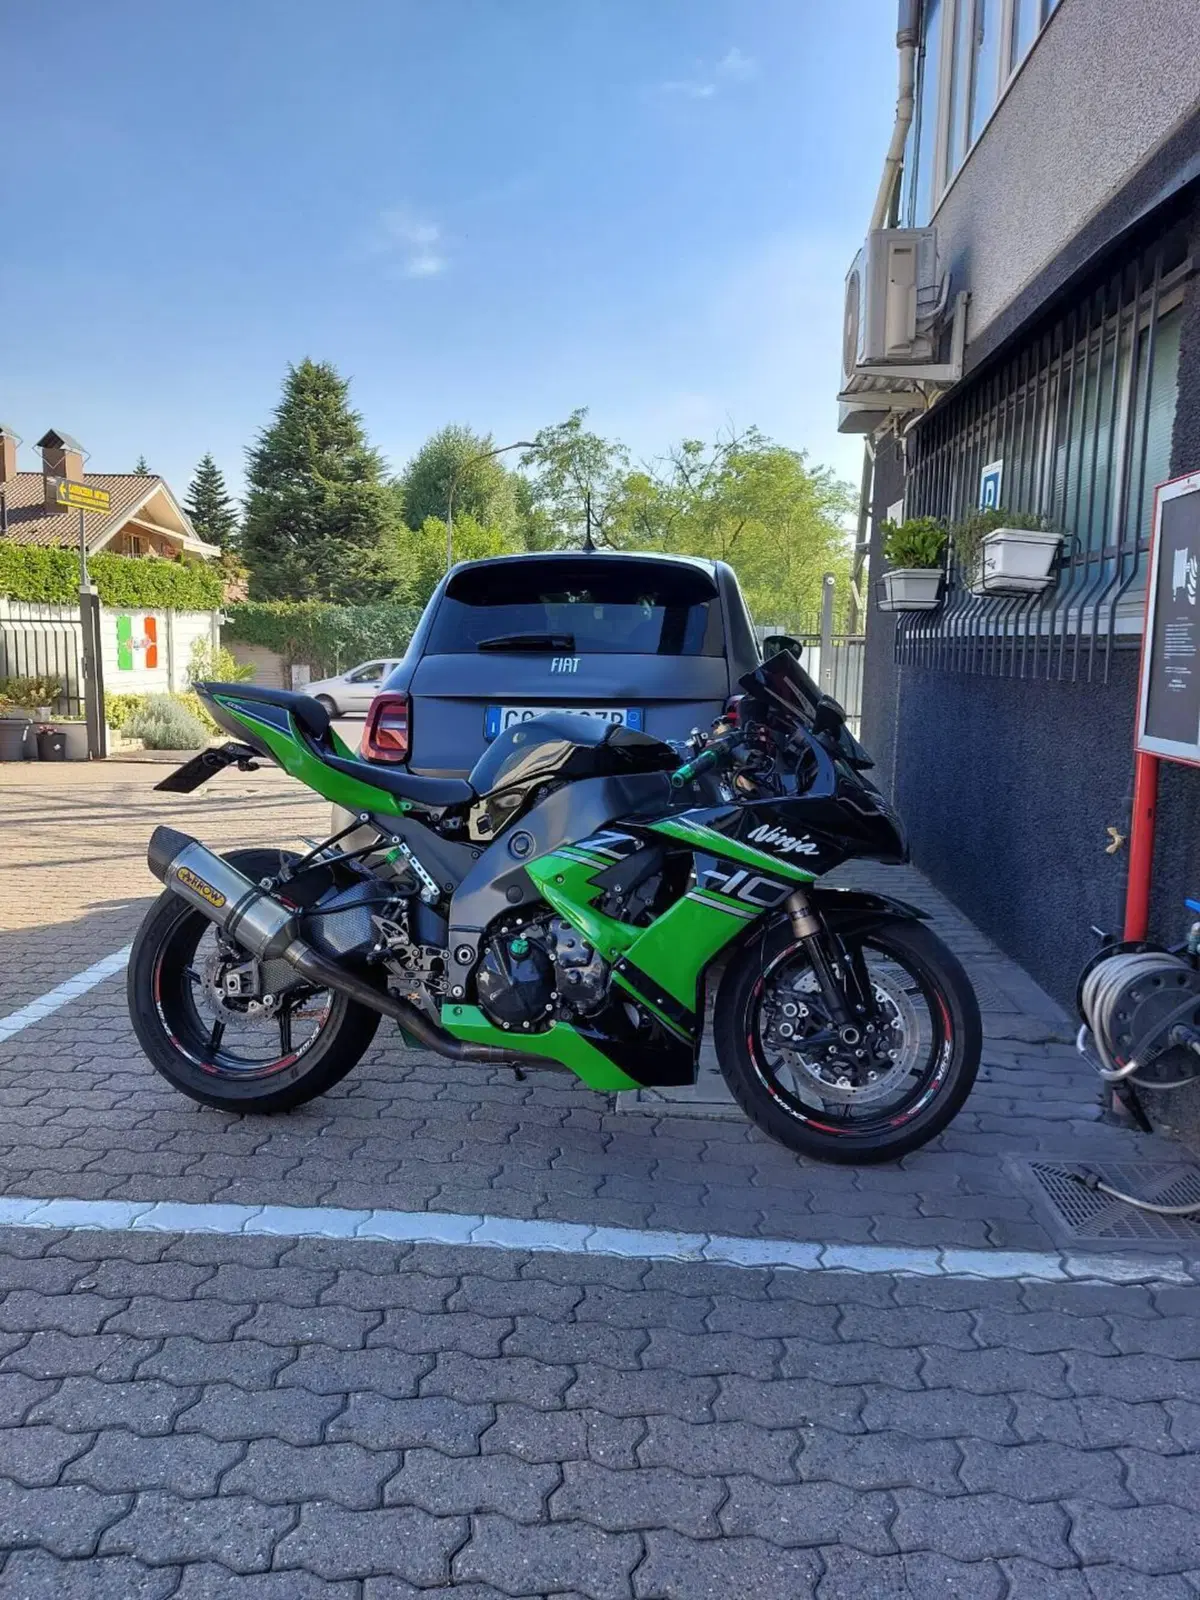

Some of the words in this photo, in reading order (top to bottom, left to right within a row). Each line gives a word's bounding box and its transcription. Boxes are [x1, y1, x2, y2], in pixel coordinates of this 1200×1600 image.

[550, 657, 582, 673] FIAT
[747, 824, 820, 855] Ninja
[182, 871, 223, 902] ARROW
